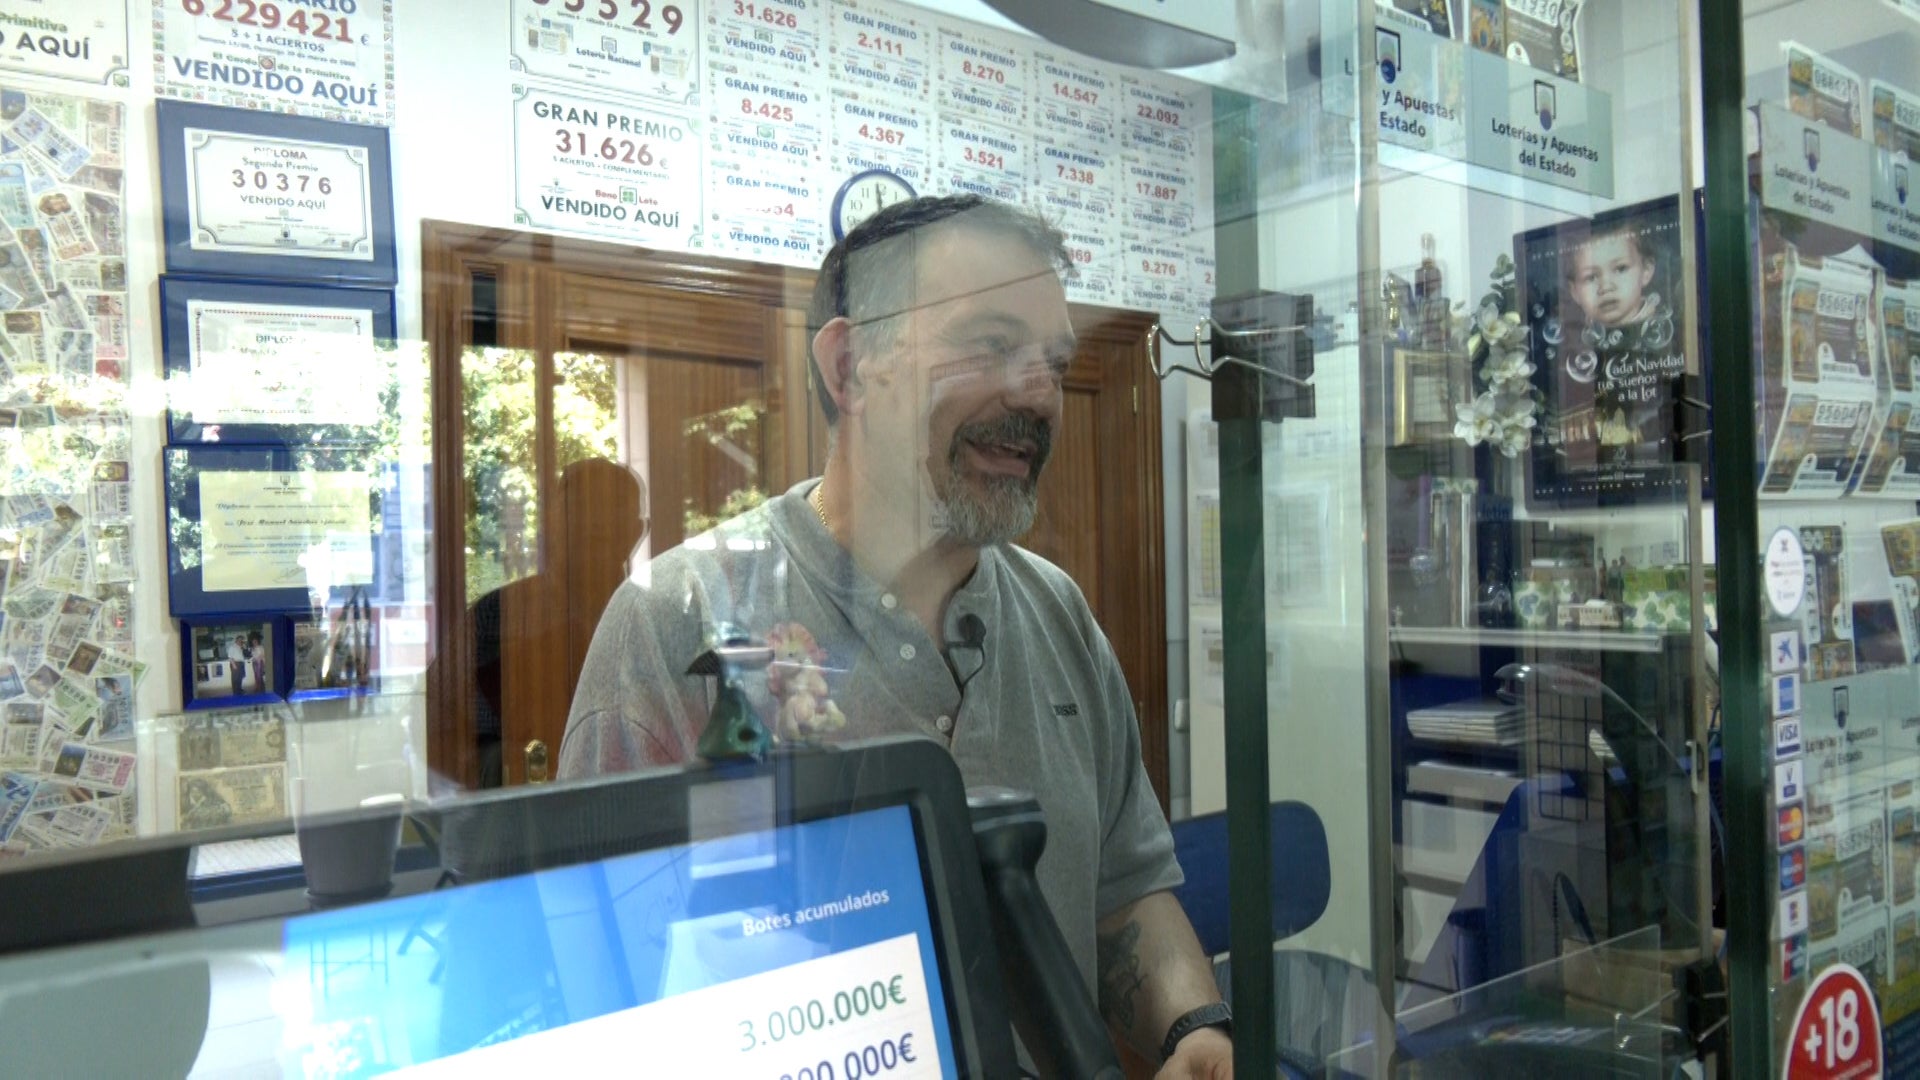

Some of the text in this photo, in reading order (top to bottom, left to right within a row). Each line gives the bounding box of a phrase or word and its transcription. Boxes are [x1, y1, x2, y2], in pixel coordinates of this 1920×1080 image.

[734, 0, 798, 28] 31.626
[843, 11, 917, 40] GRAN PREMIO
[16, 32, 90, 60] AQUÍ
[266, 35, 325, 52] ACIERTOS
[725, 35, 776, 55] VENDIDO
[858, 32, 902, 56] 2.111
[950, 41, 1016, 68] GRAN PREMIO
[173, 56, 304, 95] VENDIDO
[312, 80, 378, 107] AQUÍ
[843, 63, 890, 82] VENDIDO
[963, 60, 1005, 84] 8.270
[1045, 65, 1105, 90] GRAN PREMIO
[725, 77, 808, 104] GRAN PREMIO
[952, 91, 993, 108] VENDIDO
[1053, 83, 1098, 105] 14.547
[1130, 87, 1185, 111] GRAN PREMIO
[741, 98, 794, 122] 8.425
[844, 103, 919, 129] GRAN PREMIO
[1137, 104, 1179, 126] 22.092
[1382, 89, 1455, 121] y Apuestas
[533, 100, 683, 142] GRAN PREMIO
[1046, 113, 1084, 128] VENDIDO
[1380, 111, 1426, 138] Estado
[727, 133, 778, 151] VENDIDO
[858, 122, 905, 146] 4.367
[950, 129, 1017, 154] GRAN PREMIO
[1132, 132, 1166, 148] VENDIDO
[554, 129, 654, 167] 31.626
[963, 147, 1004, 170] 3.521
[1045, 147, 1105, 169] GRAN PREMIO
[1541, 135, 1548, 151] y
[1550, 136, 1599, 162] Apuestas
[242, 157, 319, 172] Segundo Premio
[559, 157, 595, 169] ACIERTOS
[846, 156, 892, 174] VENDIDO
[1518, 149, 1577, 178] del Estado
[726, 175, 761, 188] GRAN
[950, 177, 992, 195] VENDIDO
[1056, 164, 1094, 186] 7.338
[1130, 167, 1186, 186] GRAN PREMIO
[240, 194, 326, 210] VENDIDO AQUÍ
[595, 189, 658, 206] Bono Loto
[1046, 195, 1083, 210] VENDIDO
[1136, 182, 1178, 201] 17.887
[541, 195, 627, 221] VENDIDO
[634, 209, 679, 228] AQUÍ
[1132, 211, 1167, 224] VENDIDO
[729, 231, 780, 247] VENDIDO
[1072, 233, 1105, 246] PREMIO
[1130, 244, 1154, 255] GRAN
[1141, 259, 1177, 277] 9.276
[1636, 353, 1685, 374] Navidad
[1628, 388, 1637, 400] la
[1780, 723, 1798, 742] VISA
[742, 889, 889, 937] Botes acumulados
[738, 974, 906, 1052] 3.000.000€
[1805, 987, 1859, 1068] +18
